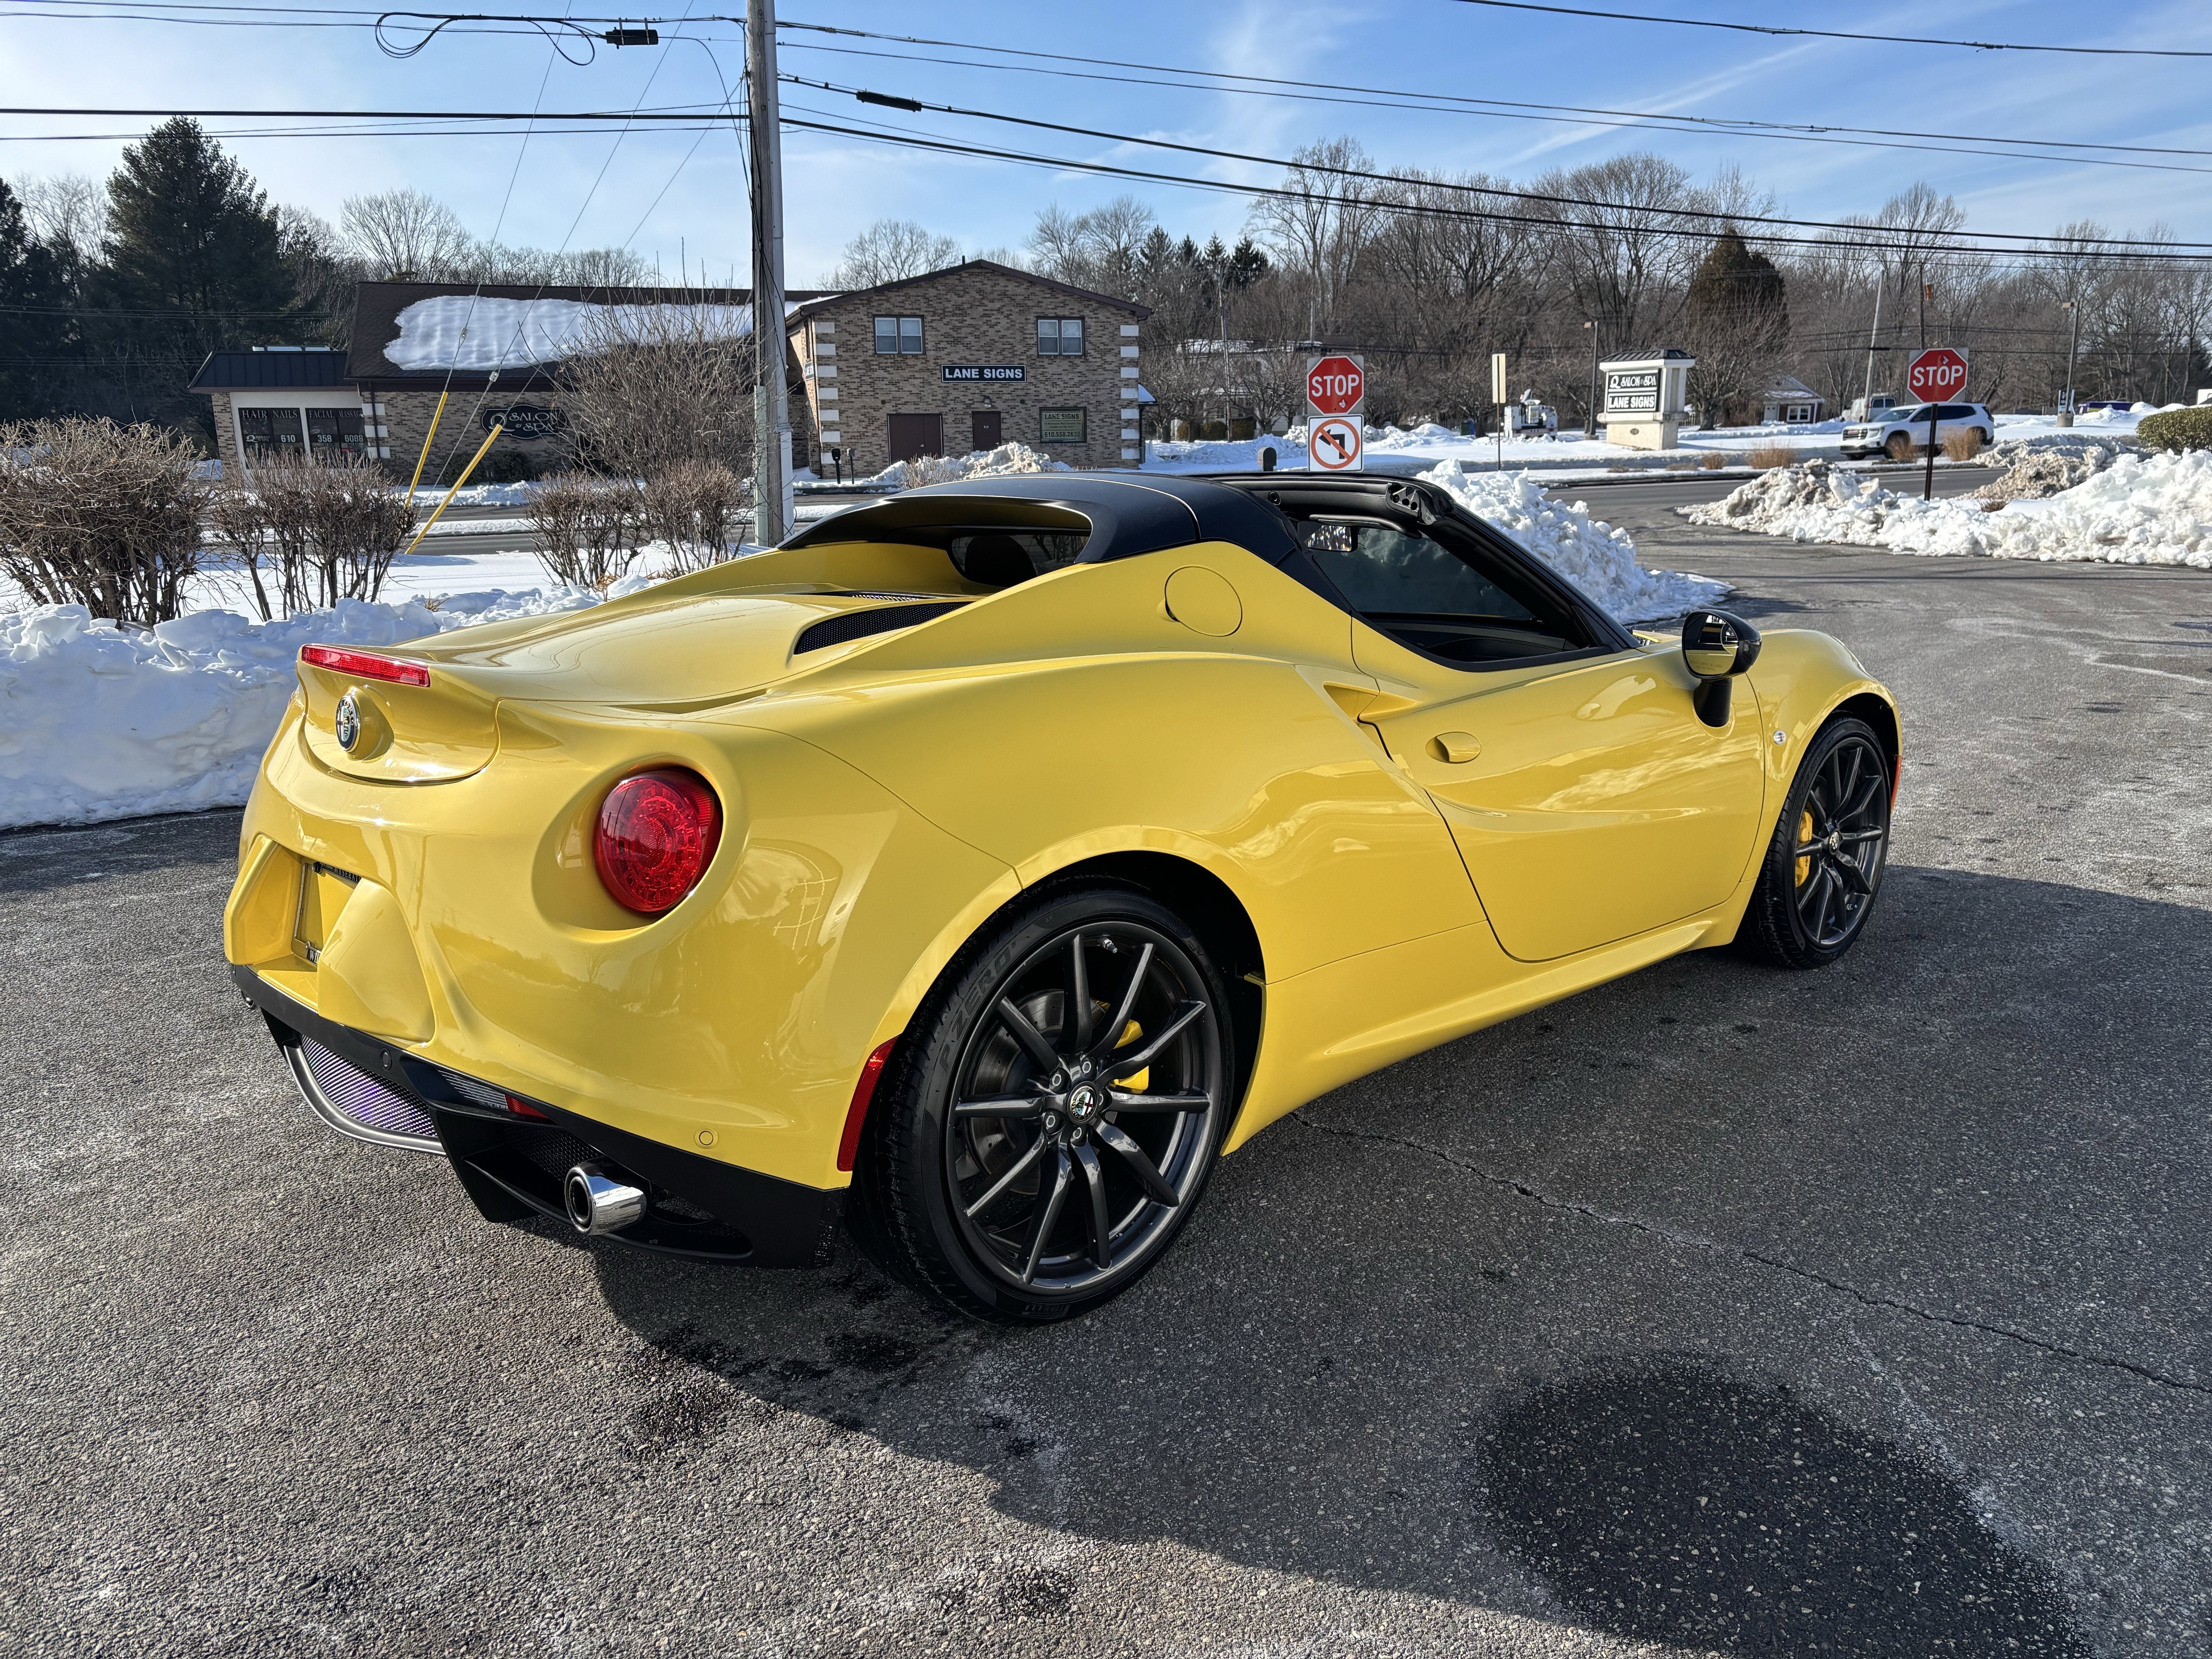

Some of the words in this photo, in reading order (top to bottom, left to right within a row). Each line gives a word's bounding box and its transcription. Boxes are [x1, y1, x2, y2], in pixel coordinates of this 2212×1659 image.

[945, 369, 979, 378] LANE
[984, 369, 1023, 378] SIGNS
[1913, 365, 1963, 386] STOP
[1312, 374, 1359, 397] STOP
[1610, 376, 1621, 389] Q
[1643, 375, 1656, 386] SPA
[1609, 397, 1630, 408] LANE
[1630, 396, 1654, 408] SIGNS
[242, 410, 268, 419] HAIR
[273, 410, 297, 419] NAILS
[309, 410, 335, 419] FACIAL
[339, 410, 362, 419] MASSAG
[509, 412, 558, 424] SALON
[523, 423, 554, 431] SPA
[281, 434, 296, 443] 610
[952, 946, 1011, 1041] ZERO
[1022, 1304, 1071, 1316] PIRELLI
